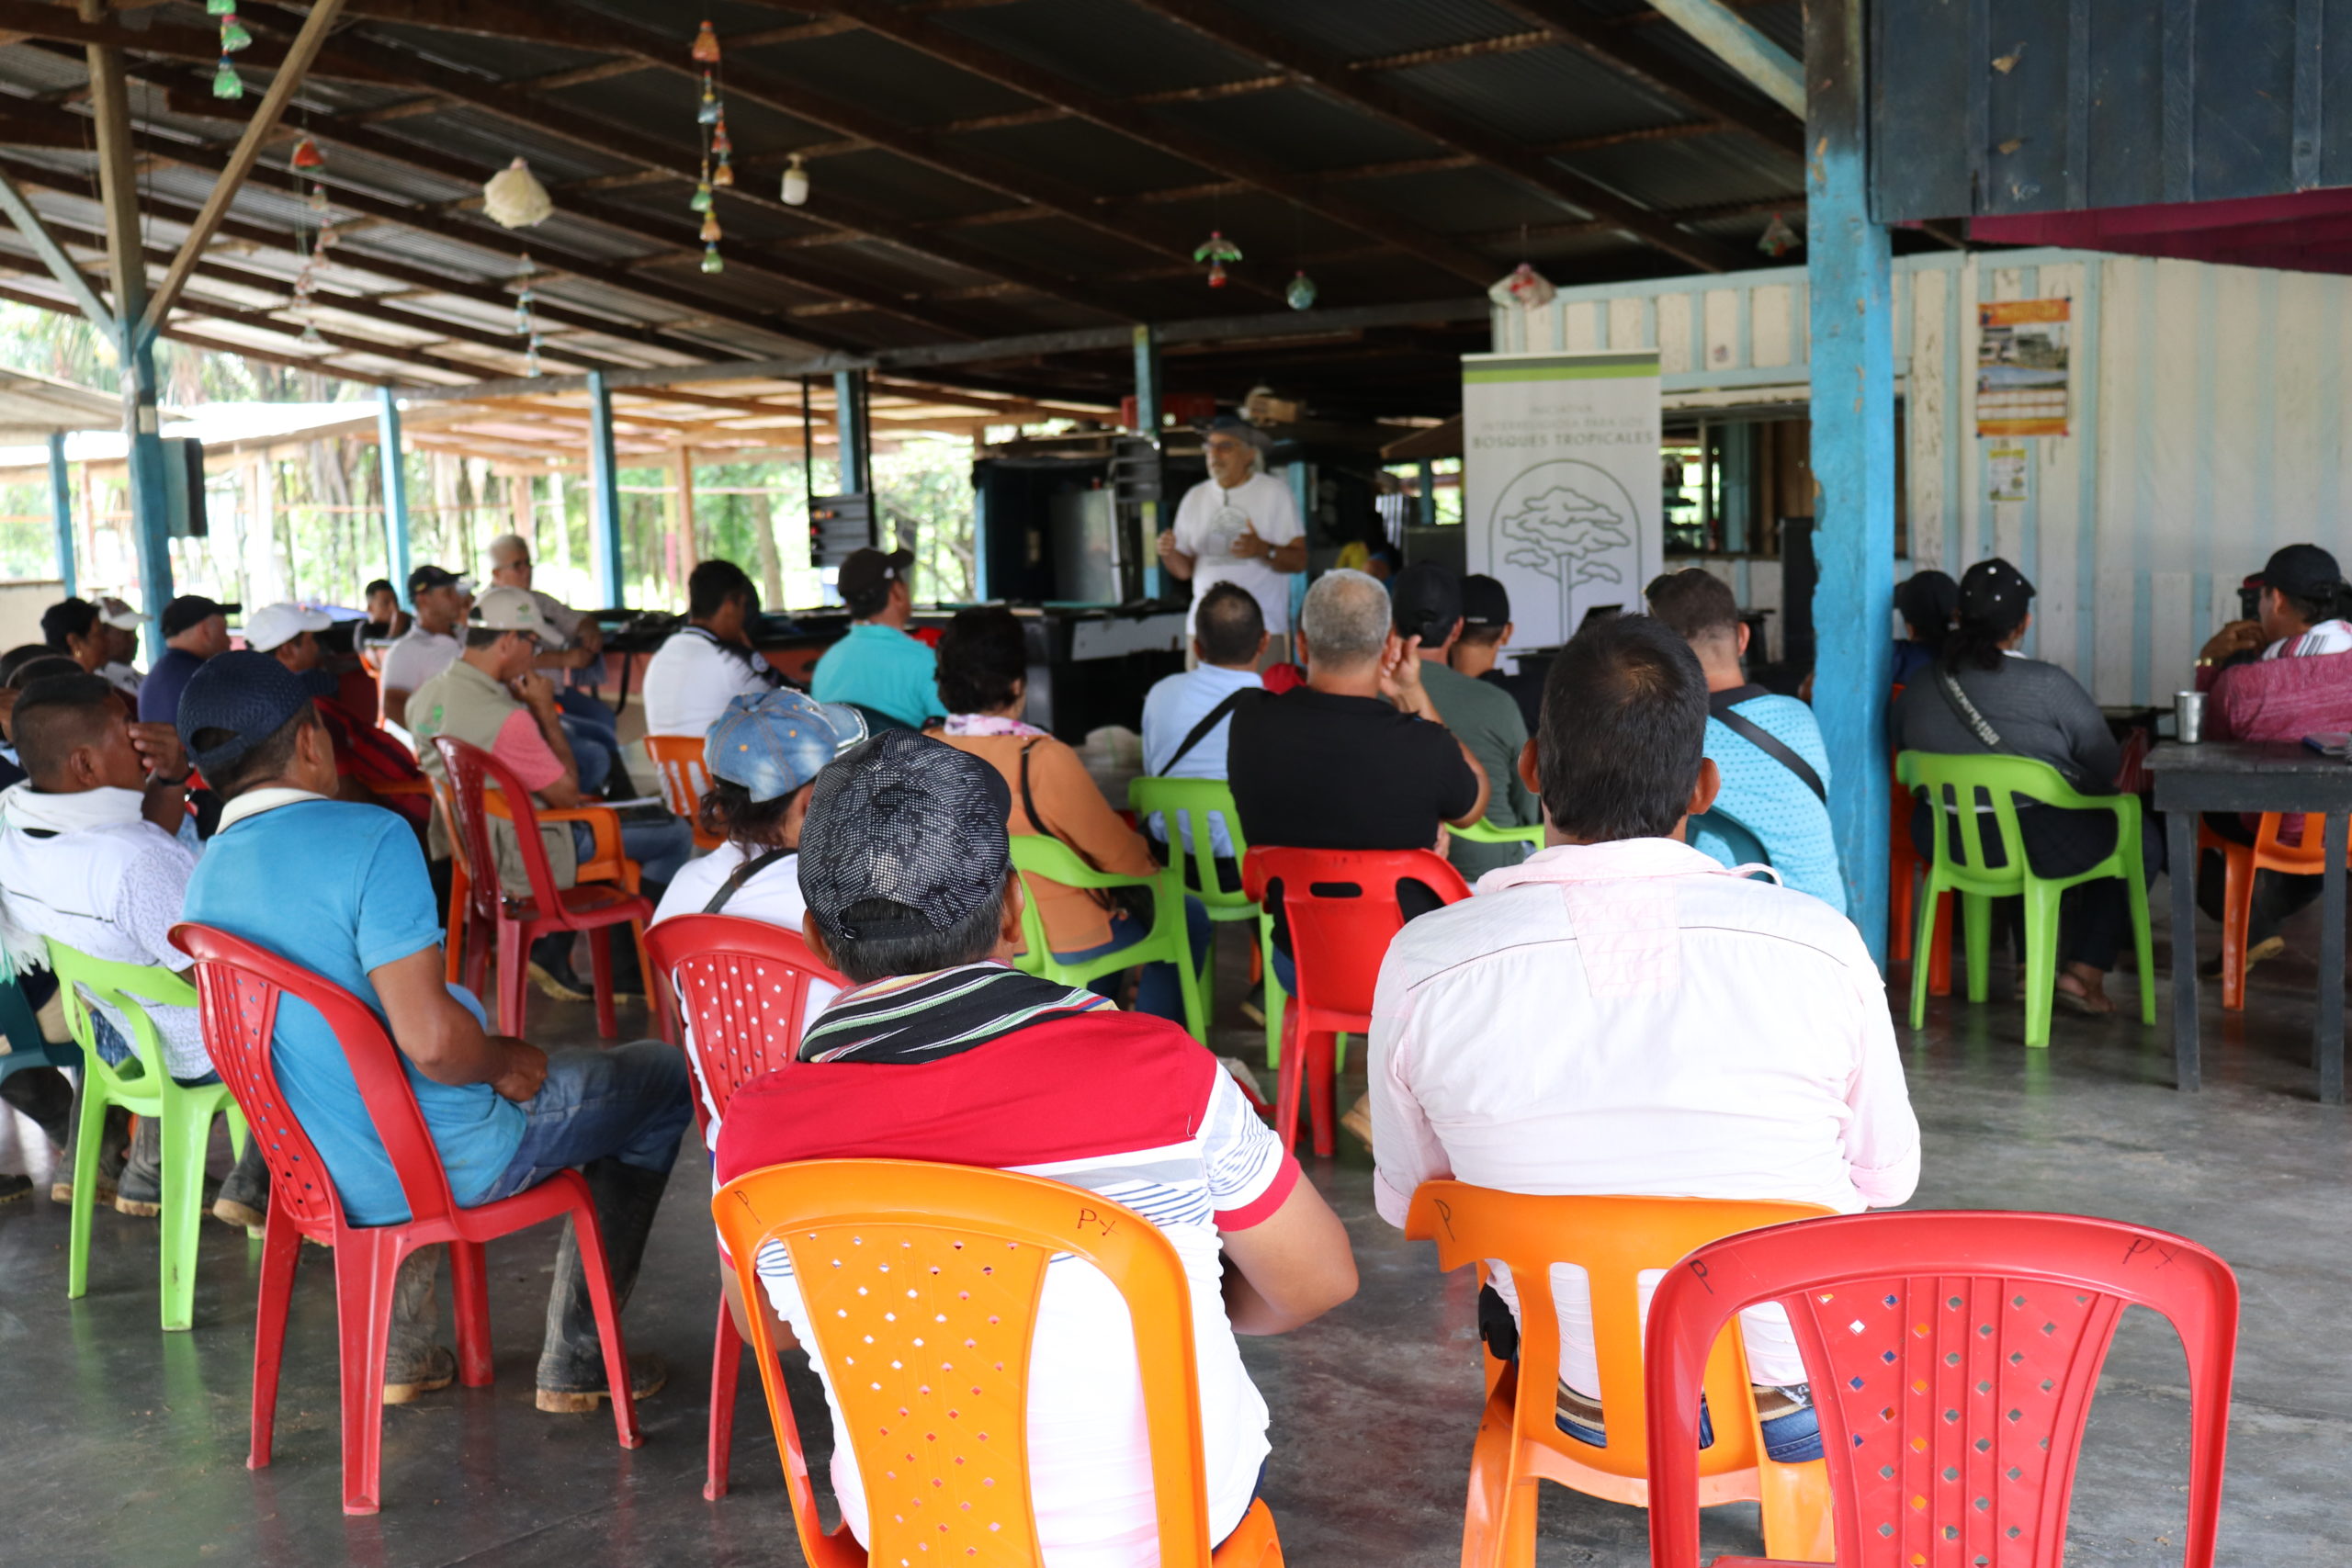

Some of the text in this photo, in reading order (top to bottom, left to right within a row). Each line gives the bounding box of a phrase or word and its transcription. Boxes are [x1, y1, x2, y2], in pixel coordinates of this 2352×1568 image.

[1472, 431, 1653, 448] BOSQUES TROPICALES
[1689, 1259, 1713, 1294] P
